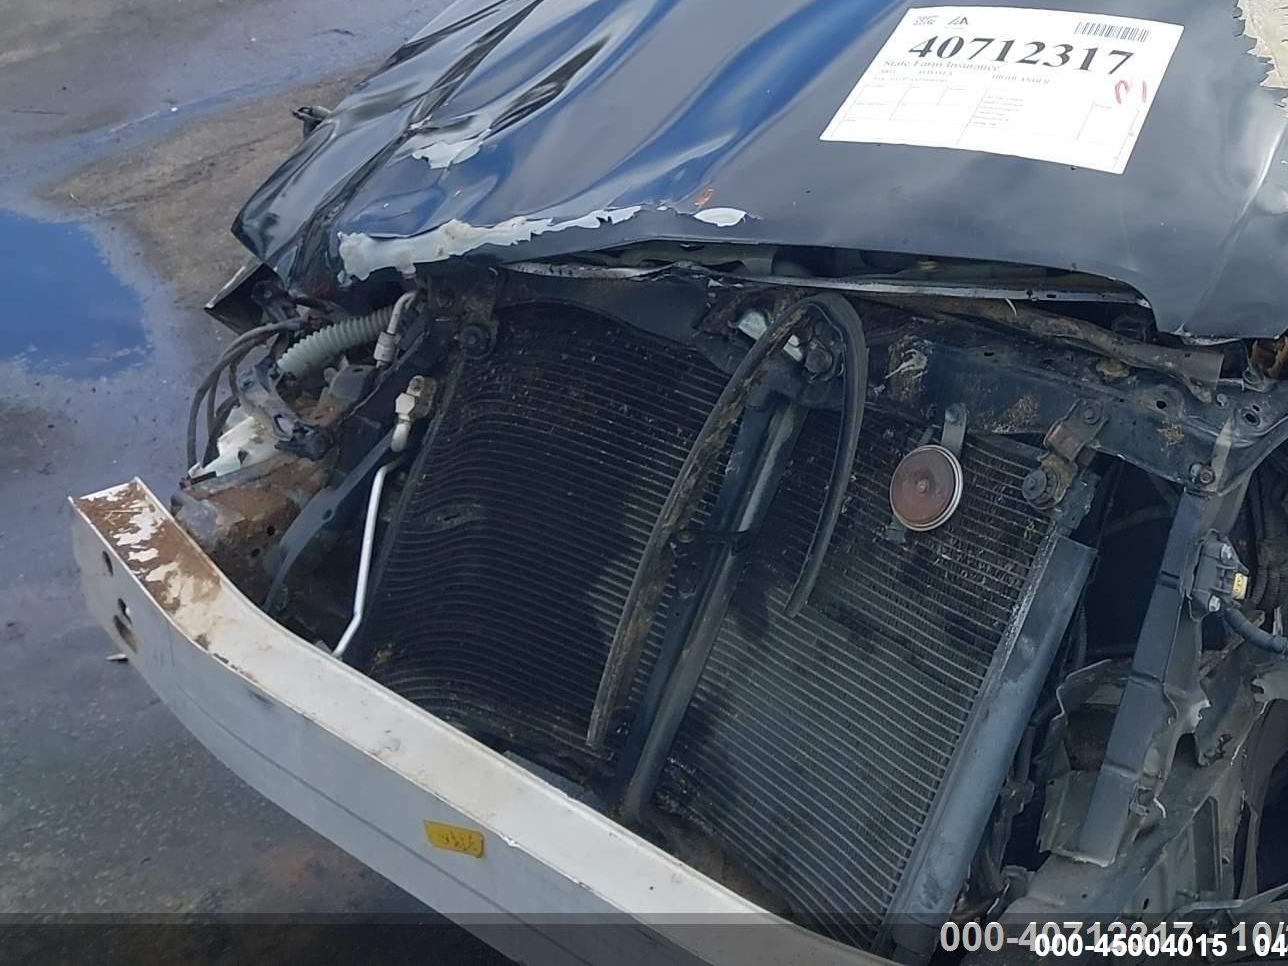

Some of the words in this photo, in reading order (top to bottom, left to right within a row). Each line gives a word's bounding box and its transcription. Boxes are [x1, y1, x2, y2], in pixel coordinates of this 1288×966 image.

[883, 59, 910, 68] State
[914, 59, 943, 68] Farm
[946, 61, 1001, 73] Insurance
[907, 34, 1135, 75] 40712317
